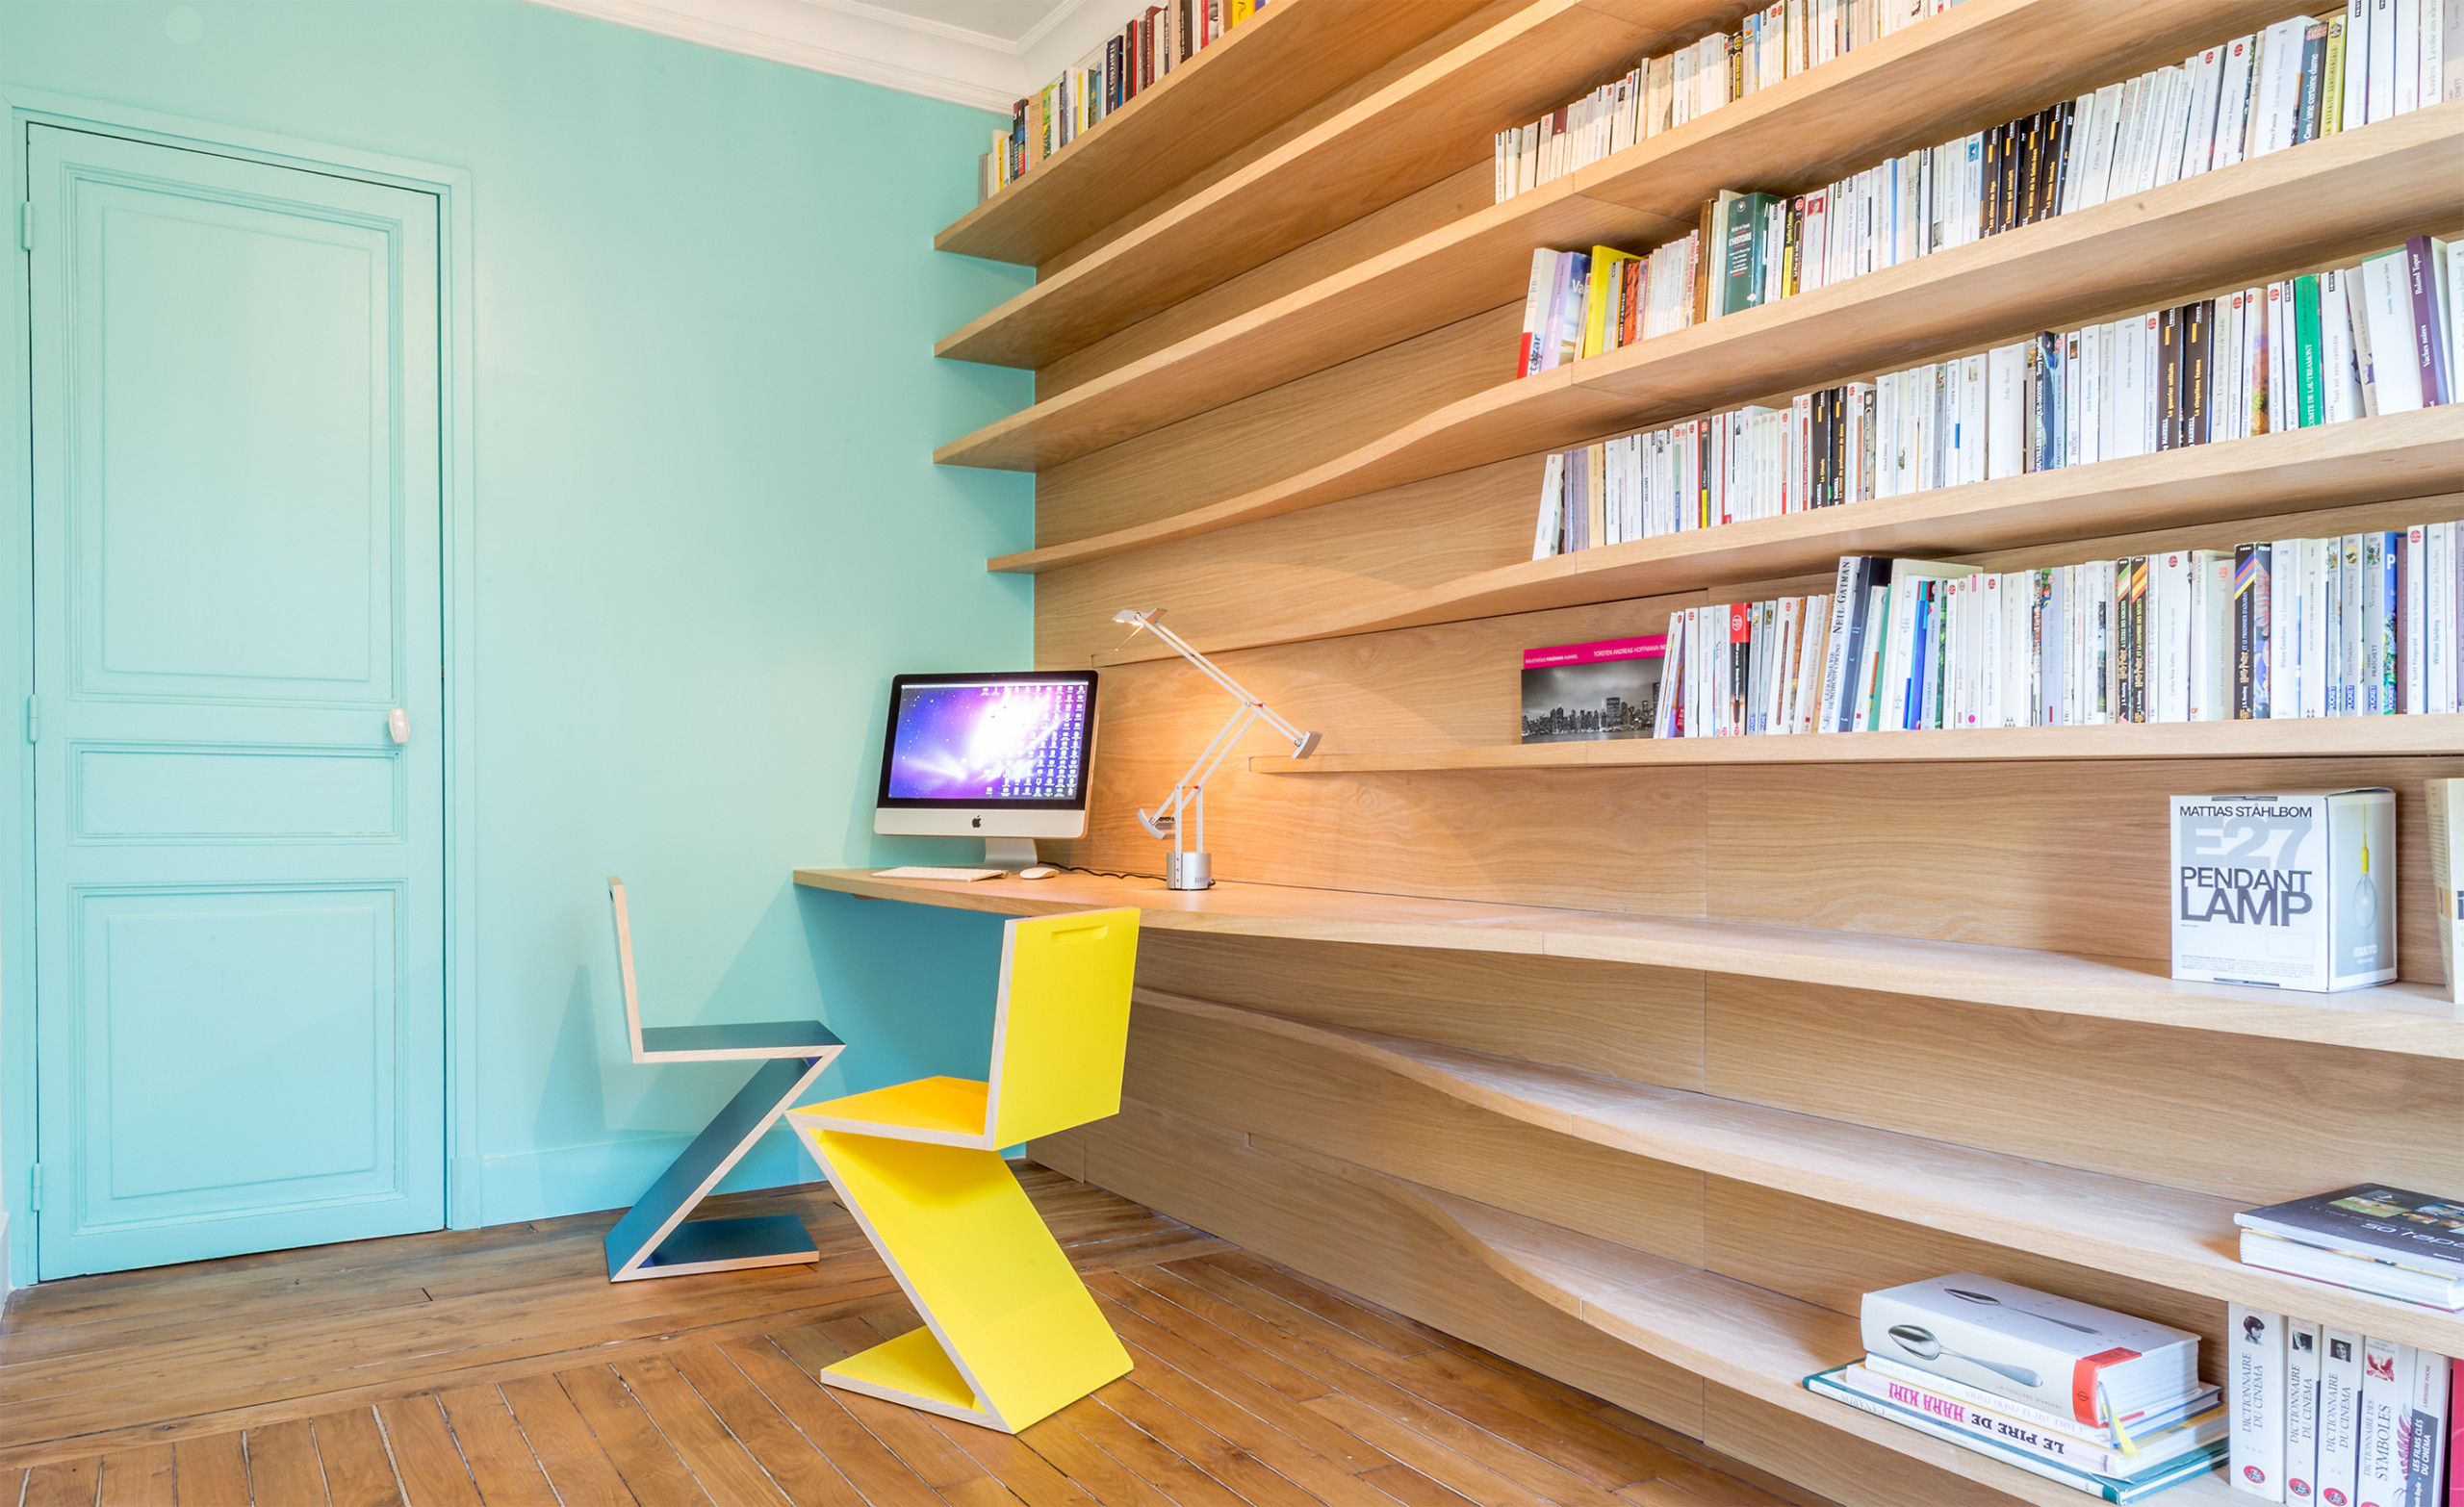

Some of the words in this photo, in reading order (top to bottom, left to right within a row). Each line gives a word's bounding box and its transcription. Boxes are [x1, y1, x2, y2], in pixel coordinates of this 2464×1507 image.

[2310, 54, 2319, 73] dame
[2327, 47, 2338, 92] SENTIMENTALE
[2306, 75, 2316, 105] certaine
[2325, 96, 2334, 124] RETRAITE
[2303, 123, 2312, 139] Cars
[2412, 253, 2421, 270] Topor
[2413, 271, 2423, 294] Roland
[2420, 324, 2429, 344] noires
[2422, 345, 2431, 368] Vaches
[2307, 395, 2314, 403] DE
[1836, 561, 1850, 603] GAIMAN
[1833, 607, 1845, 634] NEIL
[1613, 647, 1633, 655] ANDREAS
[1833, 644, 1841, 673] OWENS
[2118, 648, 2127, 665] Potter
[2239, 651, 2250, 669] Potter
[2118, 665, 2127, 679] Harry
[2135, 656, 2144, 674] Potter
[2240, 669, 2249, 683] Harry
[2135, 674, 2143, 687] Harry
[2328, 686, 2337, 711] POCKET
[2346, 685, 2355, 710] POCKET
[2369, 685, 2377, 710] POCKET
[2387, 683, 2396, 710] POCKET
[2179, 806, 2233, 817] MATTIAS
[2235, 803, 2312, 818] STÅHLBOM
[2180, 817, 2312, 870] E27
[2181, 867, 2312, 893] PENDANT
[2181, 887, 2313, 927] LAMP
[1888, 1382, 1919, 1408] KIRI
[2242, 1352, 2252, 1433] DICTIONNAIRE
[2251, 1365, 2263, 1409] CINÉMA
[1923, 1393, 1965, 1422] HARA
[2290, 1365, 2300, 1443] DICTIONNAIRE
[2301, 1378, 2312, 1420] CINÉMA
[2337, 1387, 2351, 1429] CINÉMA
[2366, 1399, 2374, 1416] DES
[1971, 1414, 1991, 1430] DE
[2253, 1412, 2263, 1428] DU
[2325, 1373, 2338, 1453] DICTIONNAIRE
[1998, 1422, 2038, 1445] PIRE
[2302, 1422, 2312, 1440] DU
[2415, 1418, 2424, 1436] CLÉS
[2043, 1438, 2065, 1454] LE
[2339, 1431, 2348, 1448] DU
[2363, 1417, 2374, 1477] DICTIONNAIRE
[2375, 1404, 2391, 1481] SYMBOLES
[2413, 1438, 2423, 1459] FILMS
[2421, 1435, 2431, 1463] CINÉMA
[2422, 1464, 2430, 1475] DU
